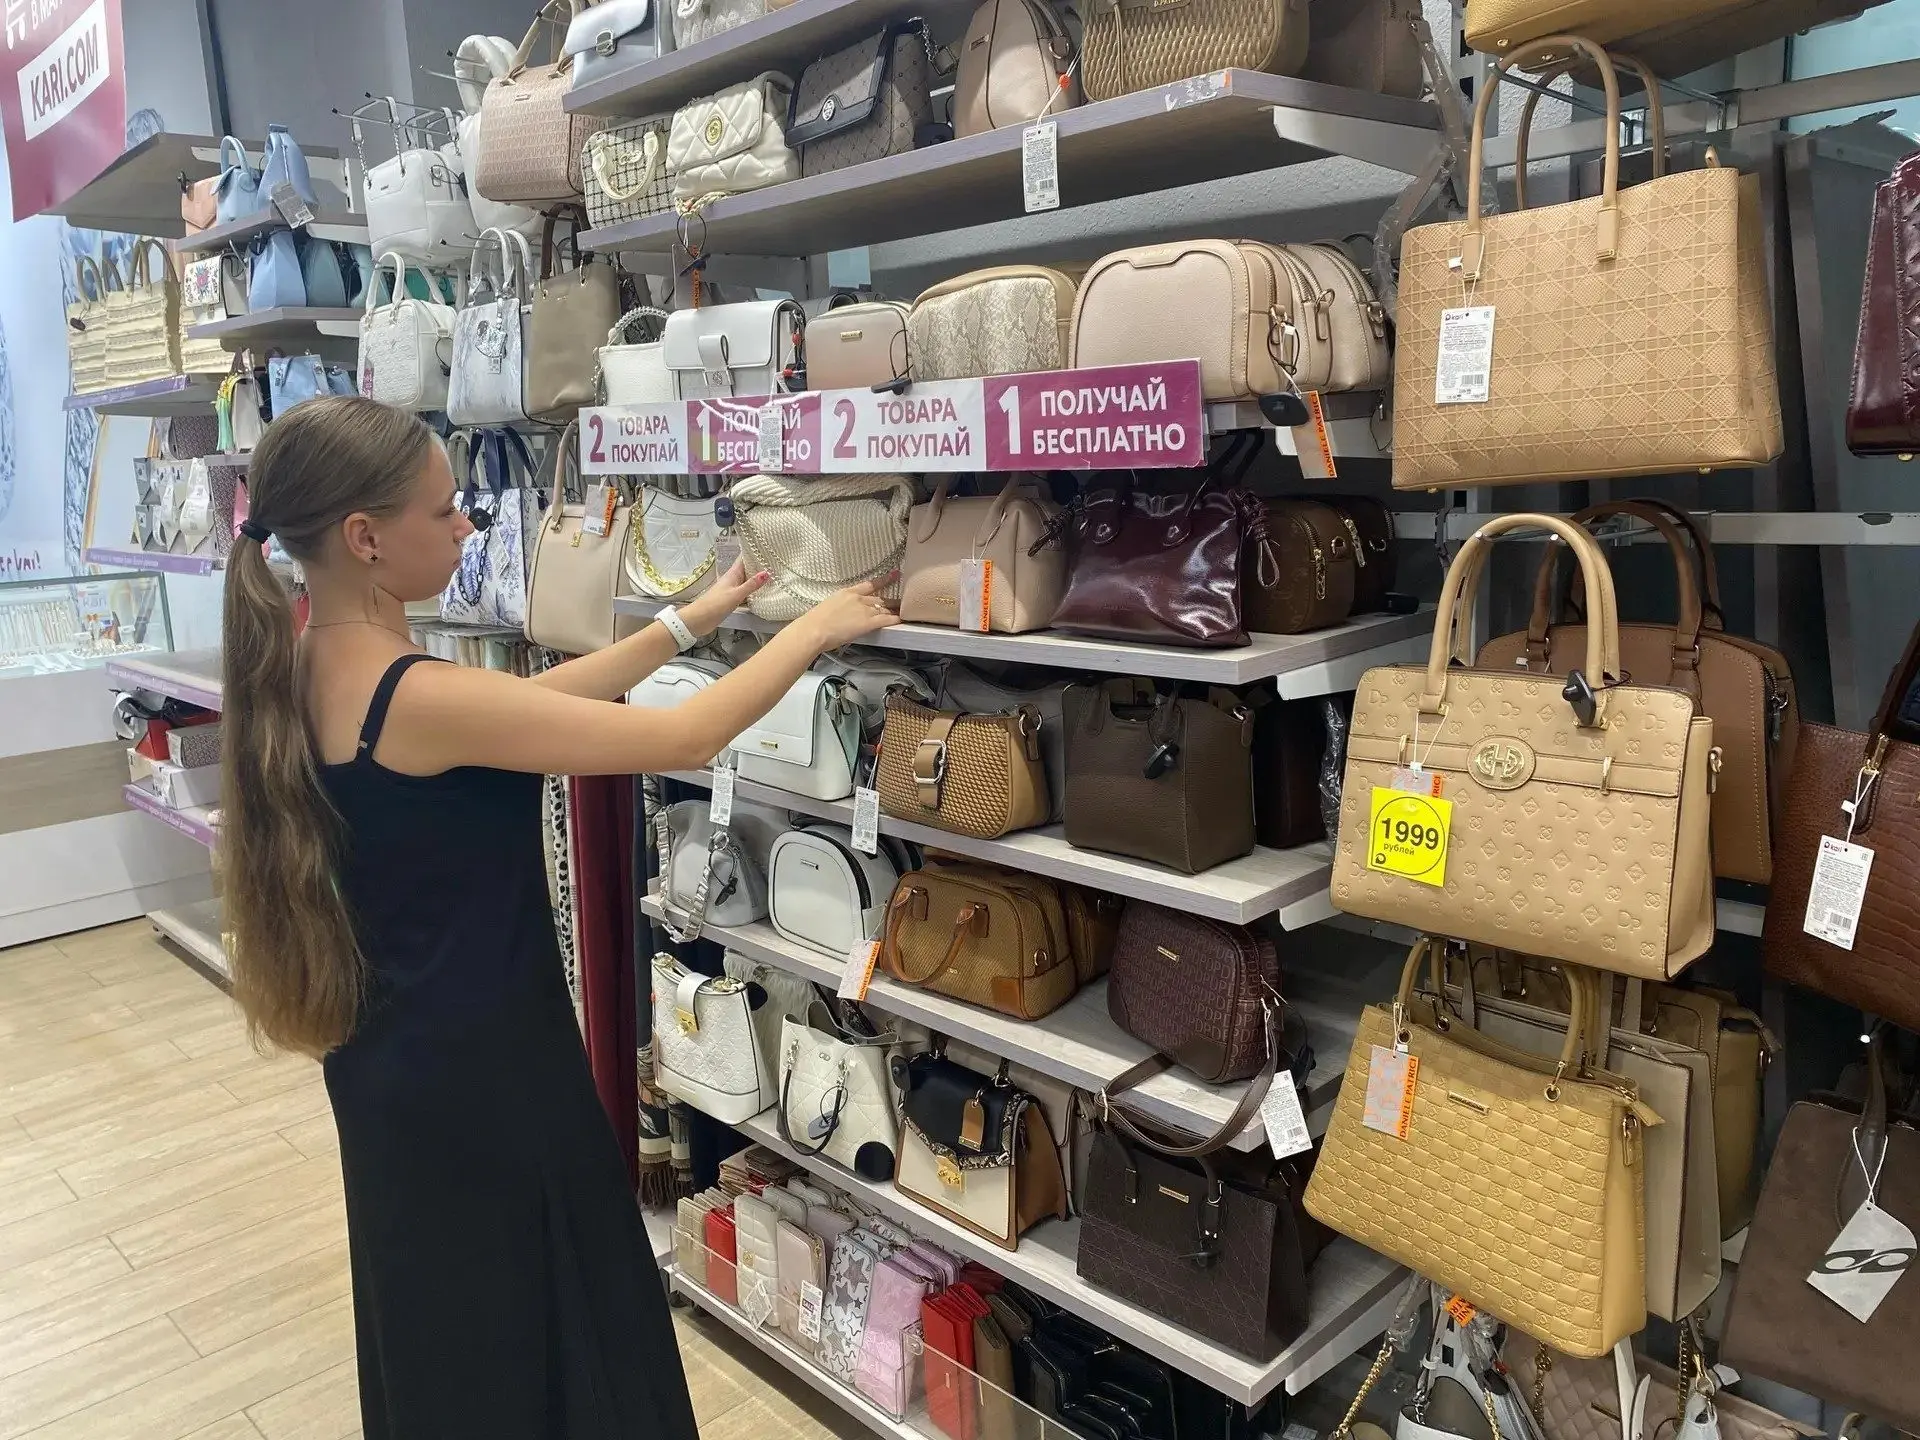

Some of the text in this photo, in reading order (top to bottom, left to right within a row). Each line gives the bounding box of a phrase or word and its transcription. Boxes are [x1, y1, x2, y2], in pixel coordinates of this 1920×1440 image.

[30, 23, 98, 121] KARI.COM
[877, 397, 957, 425] ТОВАРА
[1041, 377, 1167, 417] ПОЛУЧАЙ
[617, 415, 670, 436] ТОВАРА
[696, 407, 711, 461] 1
[833, 399, 857, 459] 2
[998, 386, 1022, 455] 1
[589, 414, 606, 463] 2
[611, 438, 679, 463] ПОКУПАЙ
[717, 439, 811, 462] БЕСПНО
[868, 426, 971, 459] ПОКУПАЙ
[1033, 423, 1186, 456] БЕСПЛАТНО
[1381, 817, 1439, 851] 1999
[1383, 842, 1415, 856] рублей
[1400, 1058, 1417, 1138] DANIELE PATRICI
